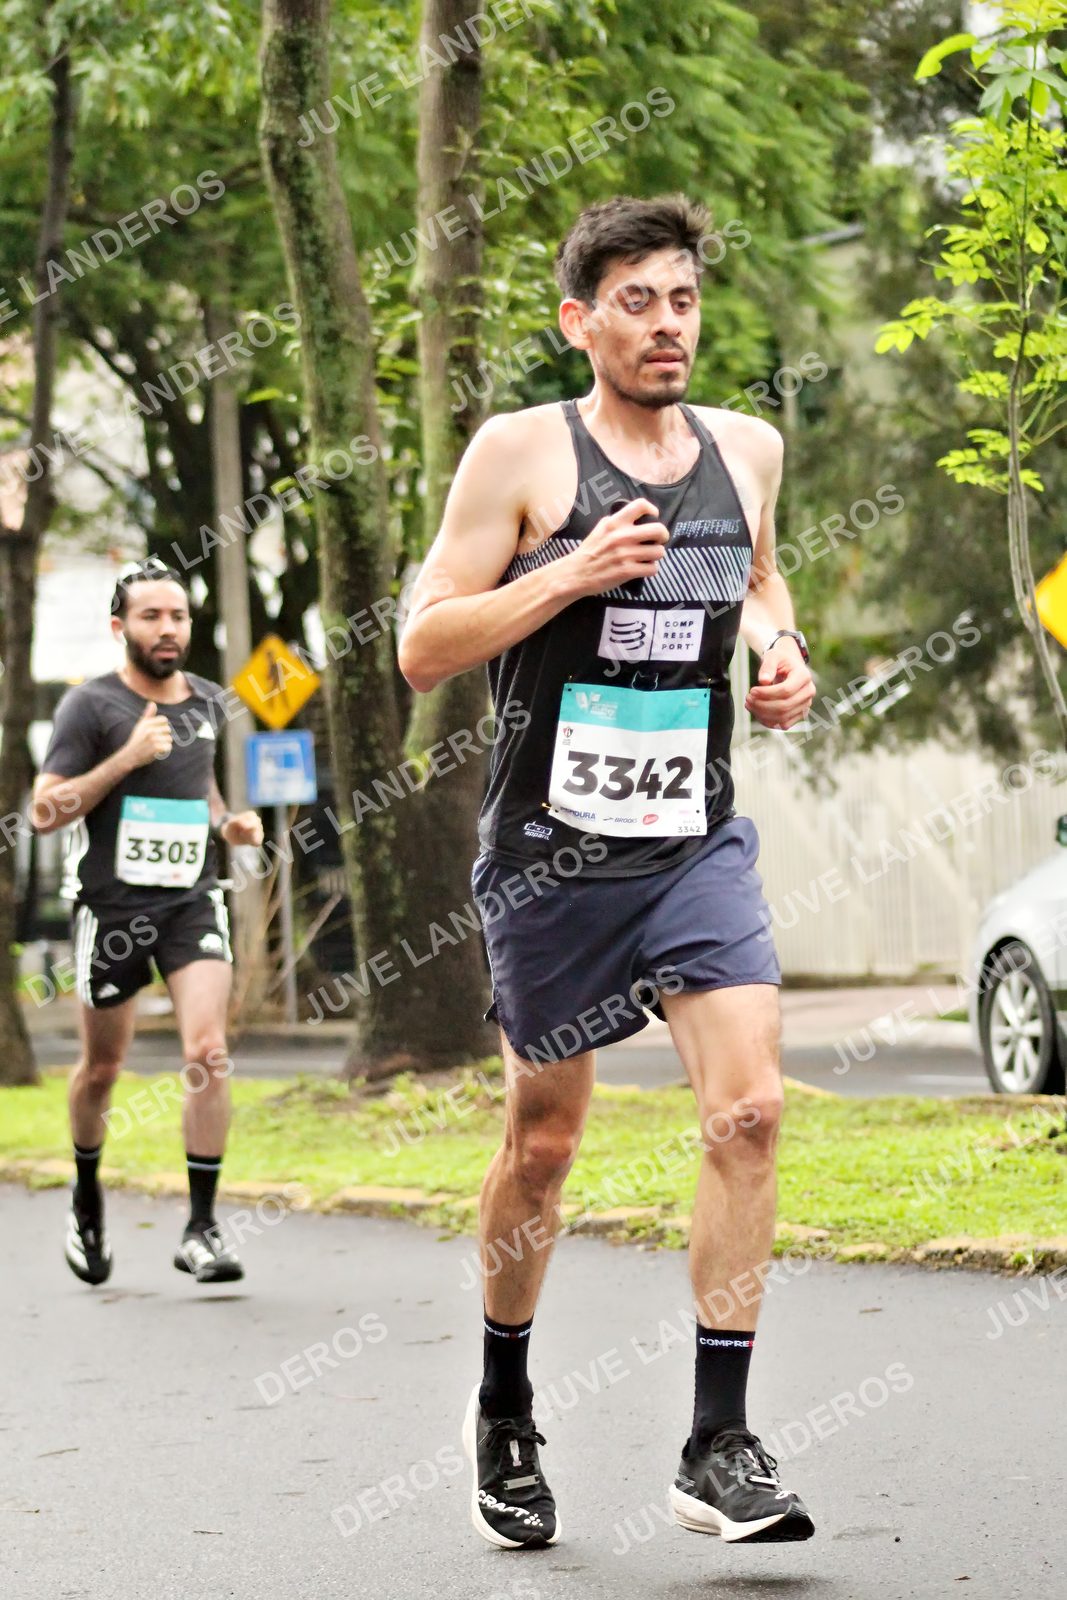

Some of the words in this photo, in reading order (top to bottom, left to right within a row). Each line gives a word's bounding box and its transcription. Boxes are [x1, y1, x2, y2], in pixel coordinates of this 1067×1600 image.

[664, 620, 694, 628] COMP
[562, 750, 693, 801] 3342
[677, 825, 701, 833] 3342
[125, 837, 199, 865] 3303
[478, 1489, 530, 1518] CRAFT
